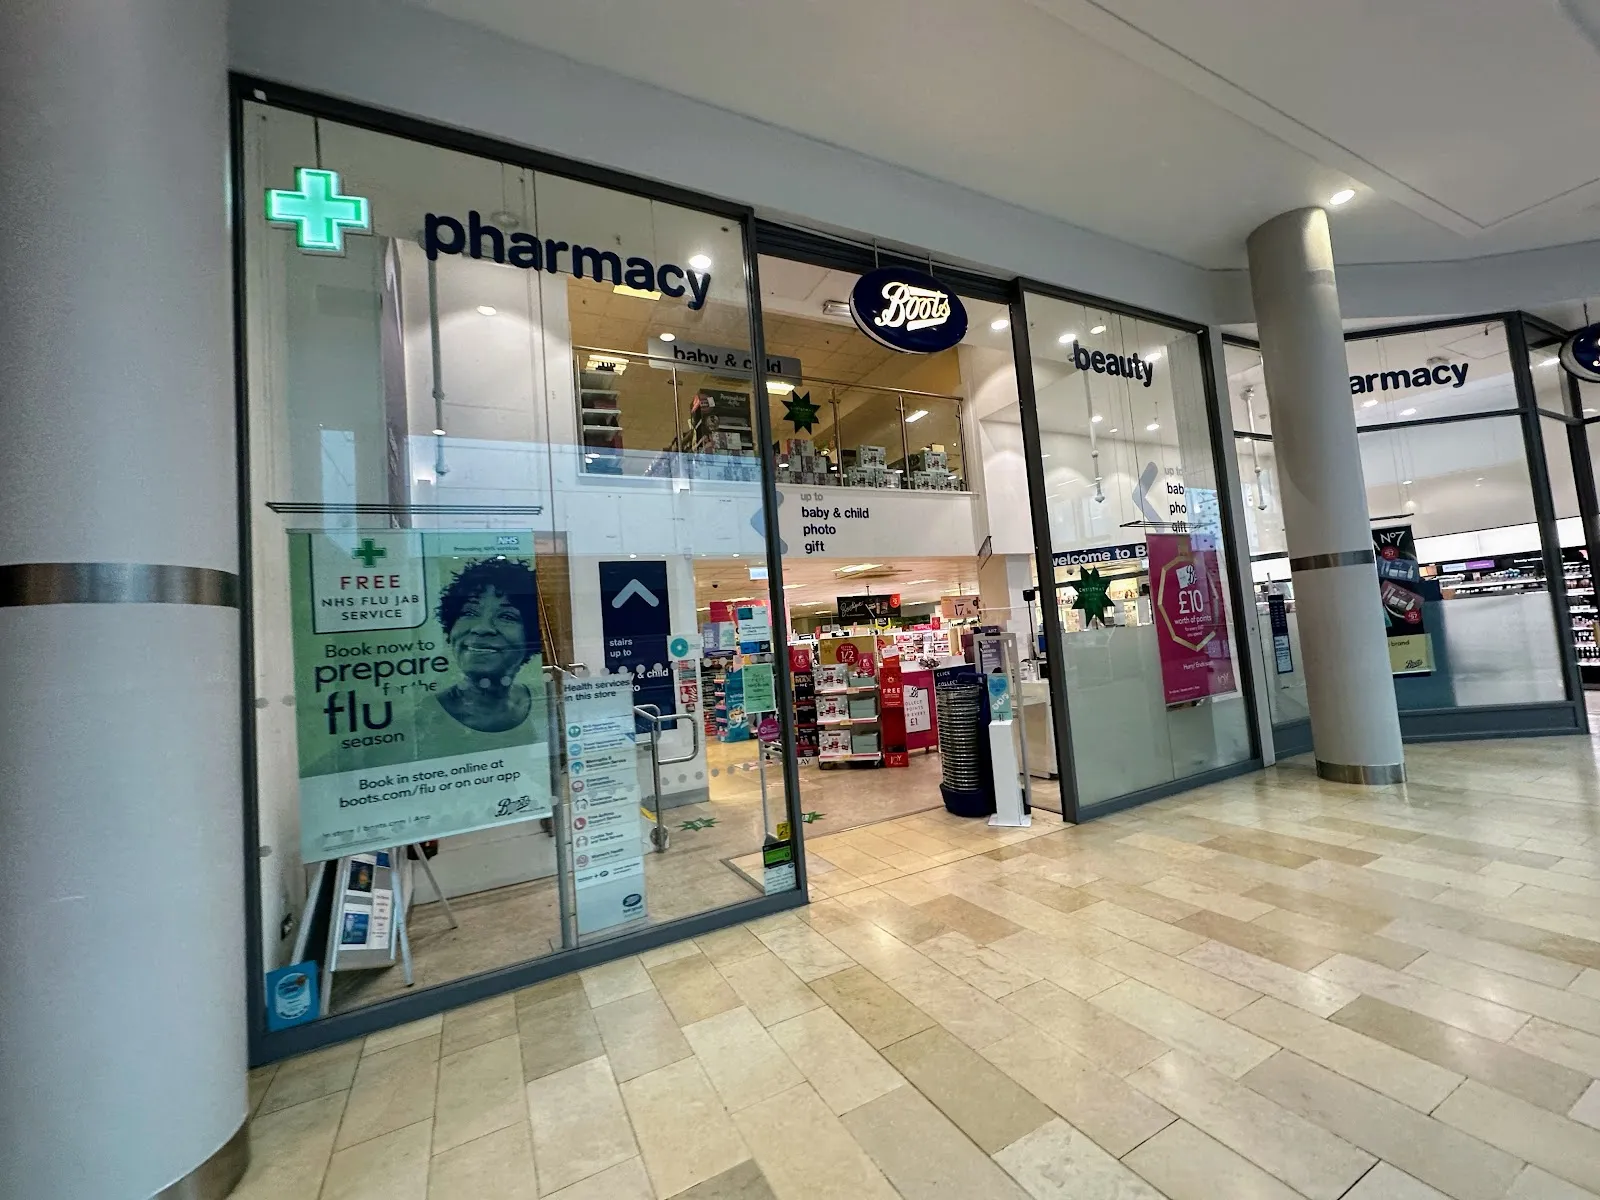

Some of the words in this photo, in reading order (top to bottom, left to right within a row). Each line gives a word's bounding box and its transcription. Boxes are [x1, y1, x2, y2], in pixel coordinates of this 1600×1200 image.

[425, 210, 711, 311] pharmacy
[874, 281, 951, 331] Boots
[673, 345, 718, 369] baby
[725, 353, 737, 368] &
[743, 358, 781, 374] cld
[1073, 339, 1153, 388] beauty
[1164, 467, 1174, 477] up
[800, 493, 811, 502] up
[814, 492, 824, 501] to
[802, 506, 829, 520] baby
[833, 508, 841, 518] &
[844, 507, 870, 519] child
[803, 524, 836, 536] photo
[498, 536, 518, 544] NHS
[804, 541, 825, 554] gift
[1052, 551, 1111, 567] welcome
[1115, 548, 1130, 559] to
[340, 575, 401, 590] FREE
[321, 597, 354, 608] NHS
[361, 596, 389, 606] FLU
[395, 594, 419, 606] JAB
[1178, 589, 1204, 615] £10
[341, 609, 403, 621] SERVICE
[1174, 617, 1191, 625] worth
[1197, 615, 1212, 625] points
[325, 642, 372, 658] Book
[376, 644, 415, 655] now
[418, 640, 435, 651] to
[609, 638, 633, 647] stairs
[1391, 639, 1410, 647] brand
[610, 650, 621, 658] up
[623, 649, 632, 657] to
[840, 650, 855, 660] 1/2
[315, 655, 449, 692] prepare
[646, 667, 669, 678] child
[383, 682, 407, 696] fr
[564, 682, 593, 692] Health
[595, 680, 630, 689] services
[575, 691, 592, 701] this
[594, 690, 617, 699] store
[323, 690, 393, 734] flu
[910, 717, 919, 726] £1
[342, 732, 404, 749] season
[358, 776, 393, 790] Book
[396, 774, 409, 785] in
[412, 770, 448, 783] store,
[450, 763, 488, 776] online
[490, 759, 504, 770] at
[339, 784, 436, 808] boots.com/flu
[439, 782, 453, 792] or
[455, 779, 472, 789] on
[474, 775, 494, 786] our
[497, 770, 521, 784] app
